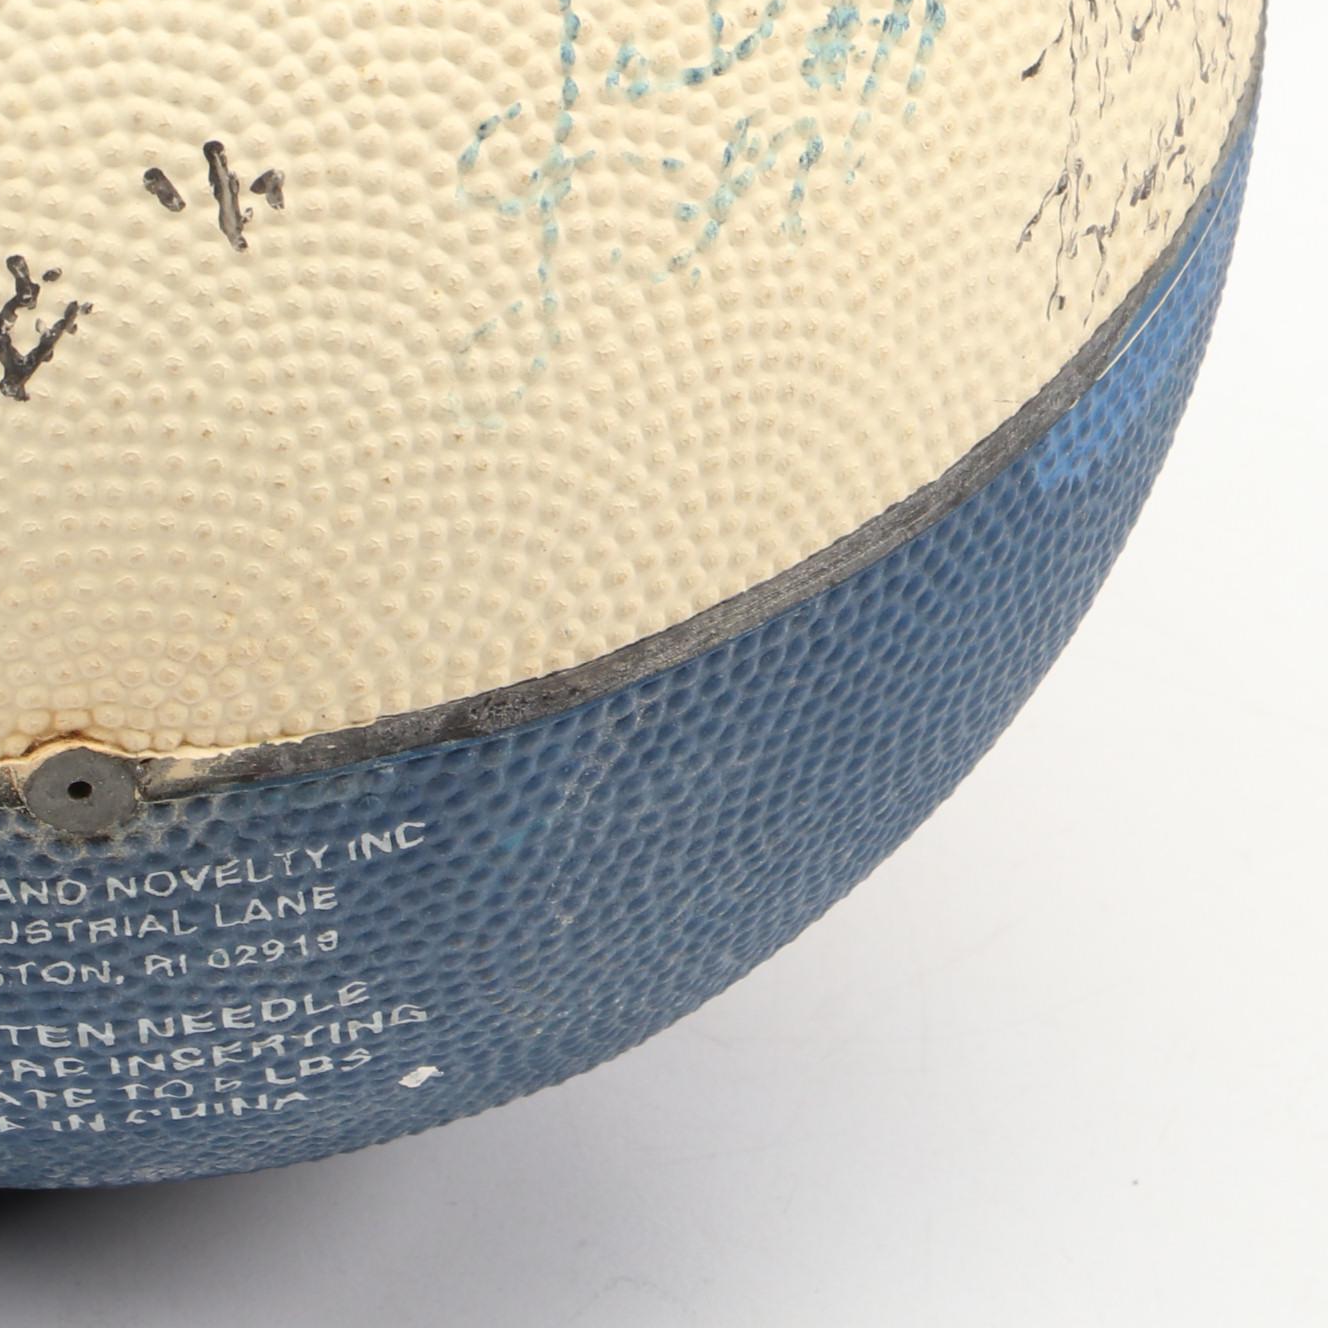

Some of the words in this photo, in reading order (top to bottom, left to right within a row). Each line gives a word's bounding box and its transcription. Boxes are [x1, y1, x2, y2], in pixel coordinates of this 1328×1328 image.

[107, 844, 329, 902] NOVELTY
[347, 822, 425, 860] INC
[215, 886, 338, 927] LANE
[145, 953, 187, 977] RI
[208, 929, 339, 968] 02919
[138, 981, 370, 1043] NEEDLE
[110, 1004, 428, 1077] INSERTING
[119, 1079, 194, 1100] TO
[265, 1047, 372, 1085] LBS
[53, 1113, 106, 1132] IN
